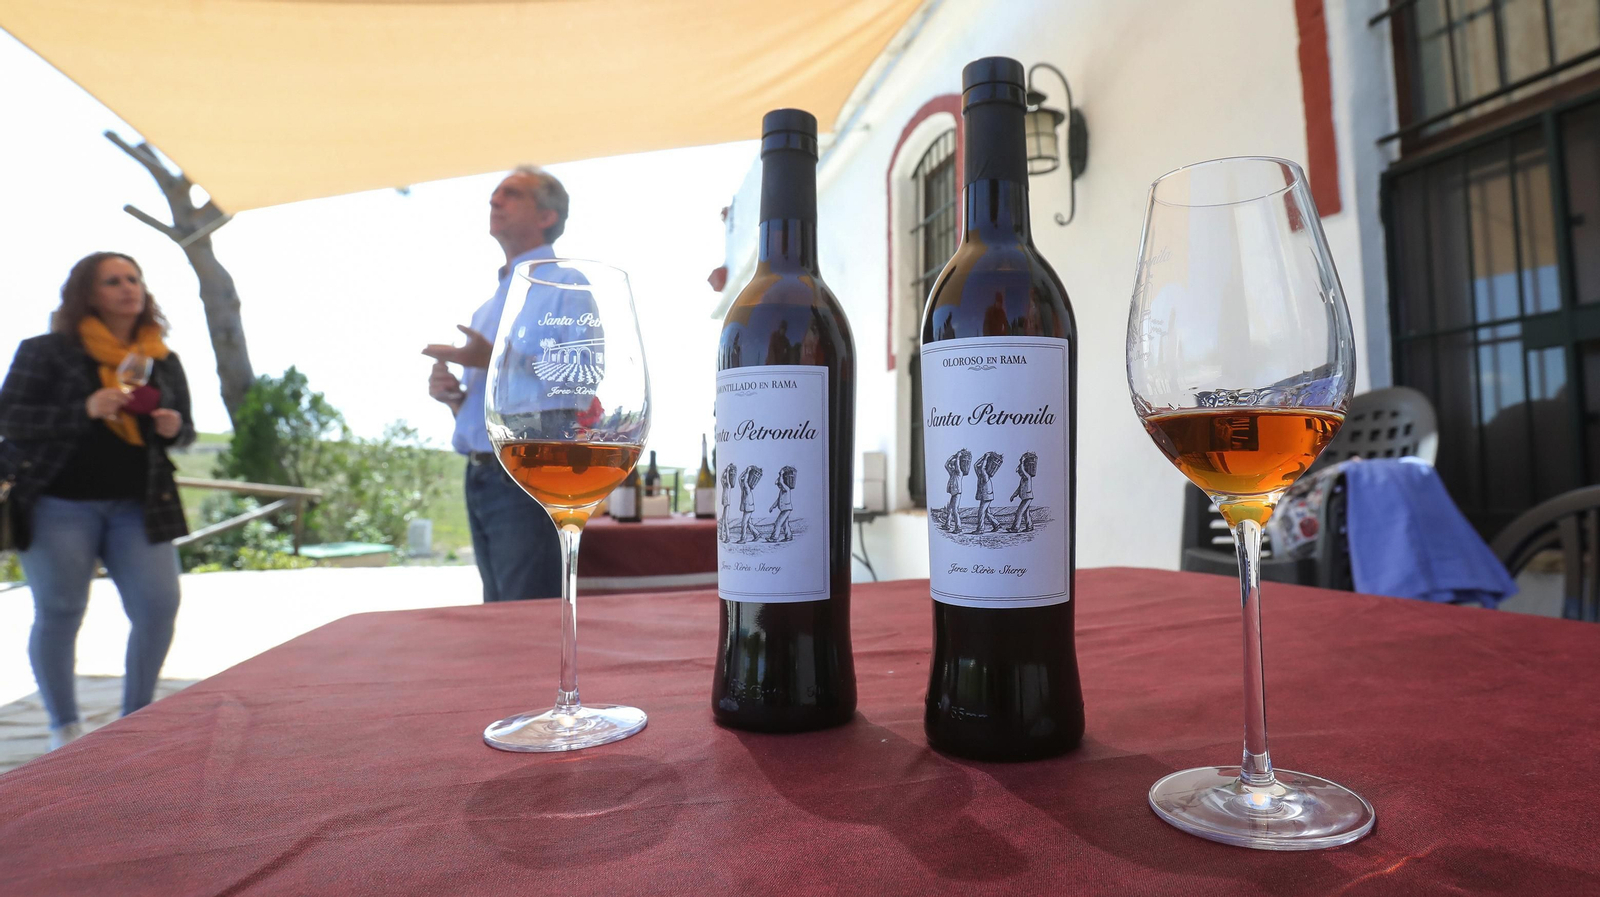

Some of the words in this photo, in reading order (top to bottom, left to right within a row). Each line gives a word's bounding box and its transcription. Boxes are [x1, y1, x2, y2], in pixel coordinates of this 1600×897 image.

[538, 312, 575, 326] Santa
[942, 356, 984, 367] OLOROSO
[986, 356, 998, 365] EN
[999, 355, 1027, 365] RAMA
[759, 381, 769, 389] EN
[771, 380, 798, 389] RAMA
[547, 386, 571, 397] Jerez
[927, 406, 964, 428] Santa
[967, 402, 1057, 426] Petronila
[733, 419, 819, 441] Petronila
[734, 562, 751, 571] Xérès
[754, 563, 782, 575] Sherry
[948, 563, 968, 574] Jerez
[971, 564, 996, 575] Xérès
[998, 564, 1027, 577] Sherry
